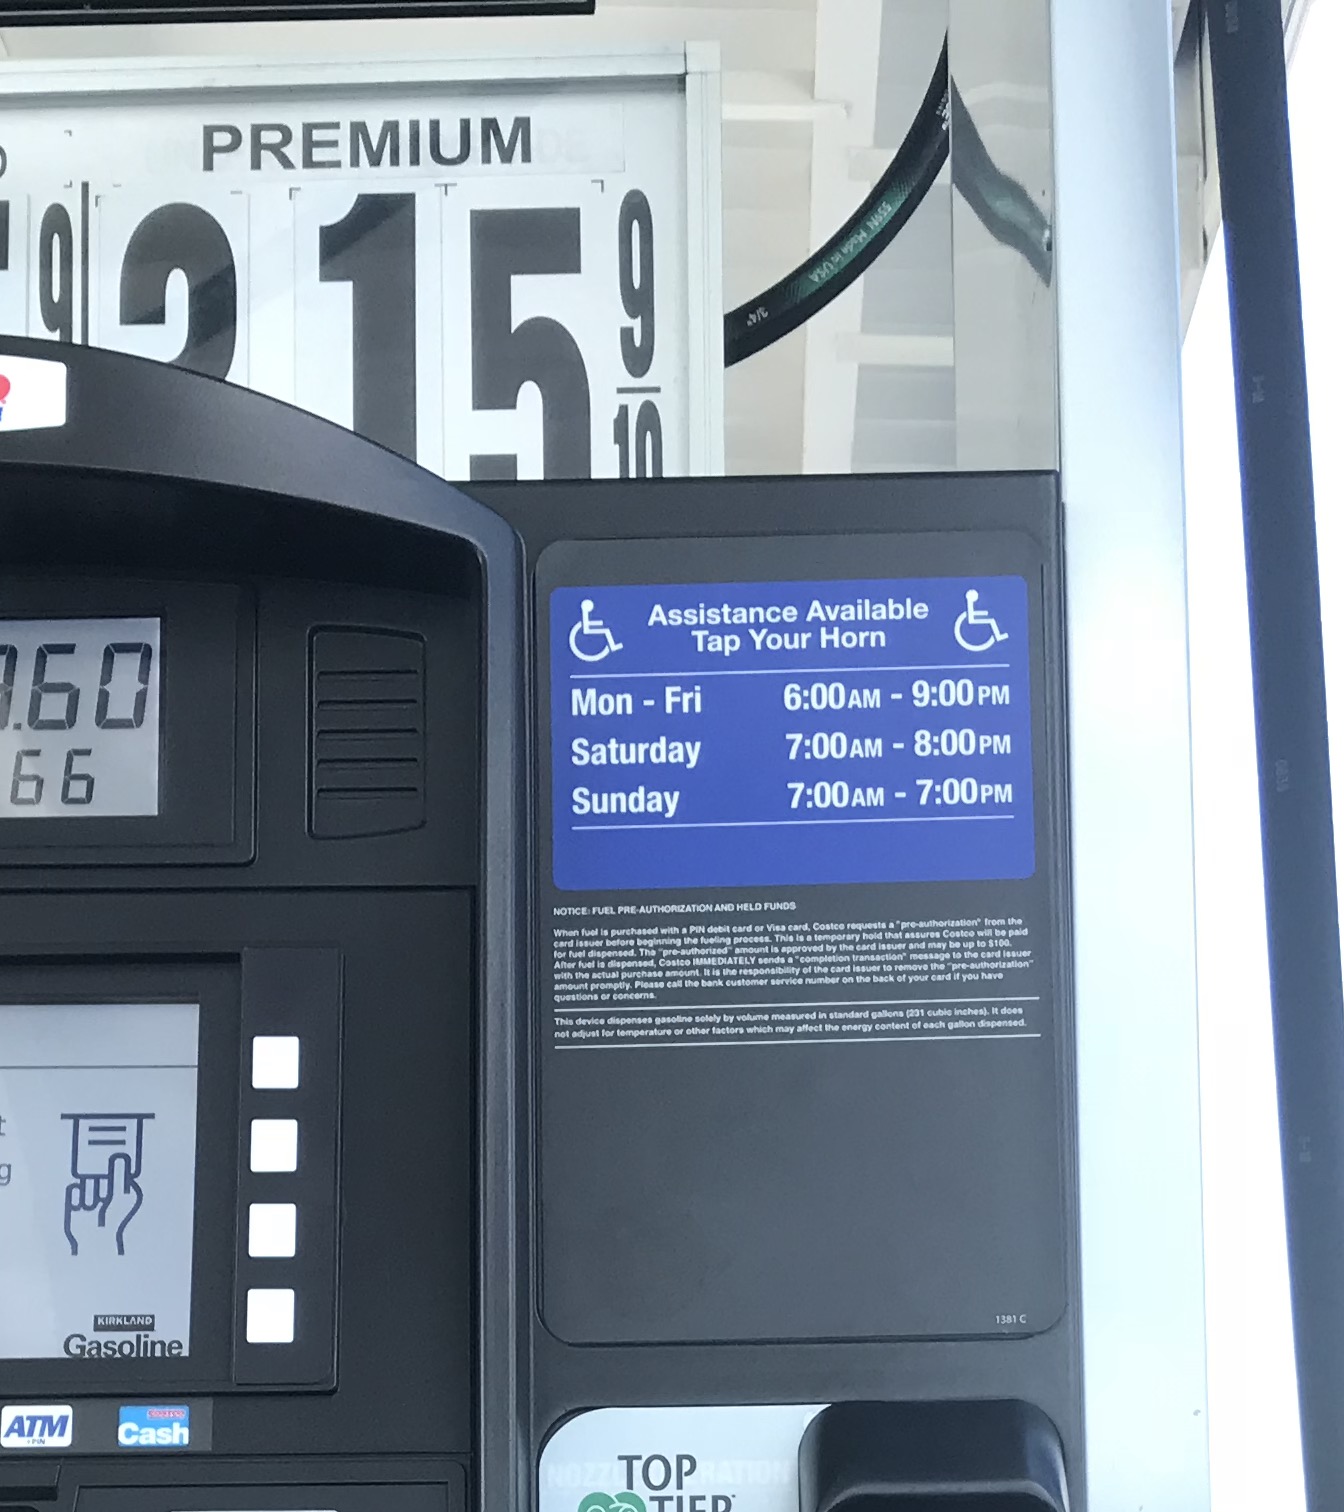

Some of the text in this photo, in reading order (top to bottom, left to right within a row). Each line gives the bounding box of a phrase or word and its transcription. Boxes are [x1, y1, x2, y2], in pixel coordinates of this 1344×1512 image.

[203, 117, 531, 171] PREMIUM
[648, 598, 929, 626] Assistance Available
[691, 626, 885, 657] Tap Your Horn
[572, 688, 632, 716] Mon
[666, 685, 701, 714] Fri
[784, 682, 880, 711] 6:00AM
[912, 679, 1009, 707] 9:00PM
[572, 737, 701, 768] Saturday
[786, 732, 882, 760] 7:00AM
[915, 729, 1011, 756] 8:00PM
[573, 786, 679, 818] Sunday
[788, 781, 884, 809] 7:00AM
[916, 777, 1012, 805] 7:00PM
[592, 906, 616, 915] FUEL
[618, 904, 712, 915] PRE-AUTHORIZATION
[714, 903, 734, 913] AND
[737, 903, 762, 912] HELD
[764, 902, 796, 912] FUNDS
[98, 1316, 152, 1325] KIRKLAND
[996, 1314, 1026, 1325] 1381 C
[63, 1334, 183, 1358] Gasoline
[3, 1415, 69, 1439] ATM
[118, 1422, 189, 1446] Cash
[618, 1454, 696, 1494] TOP
